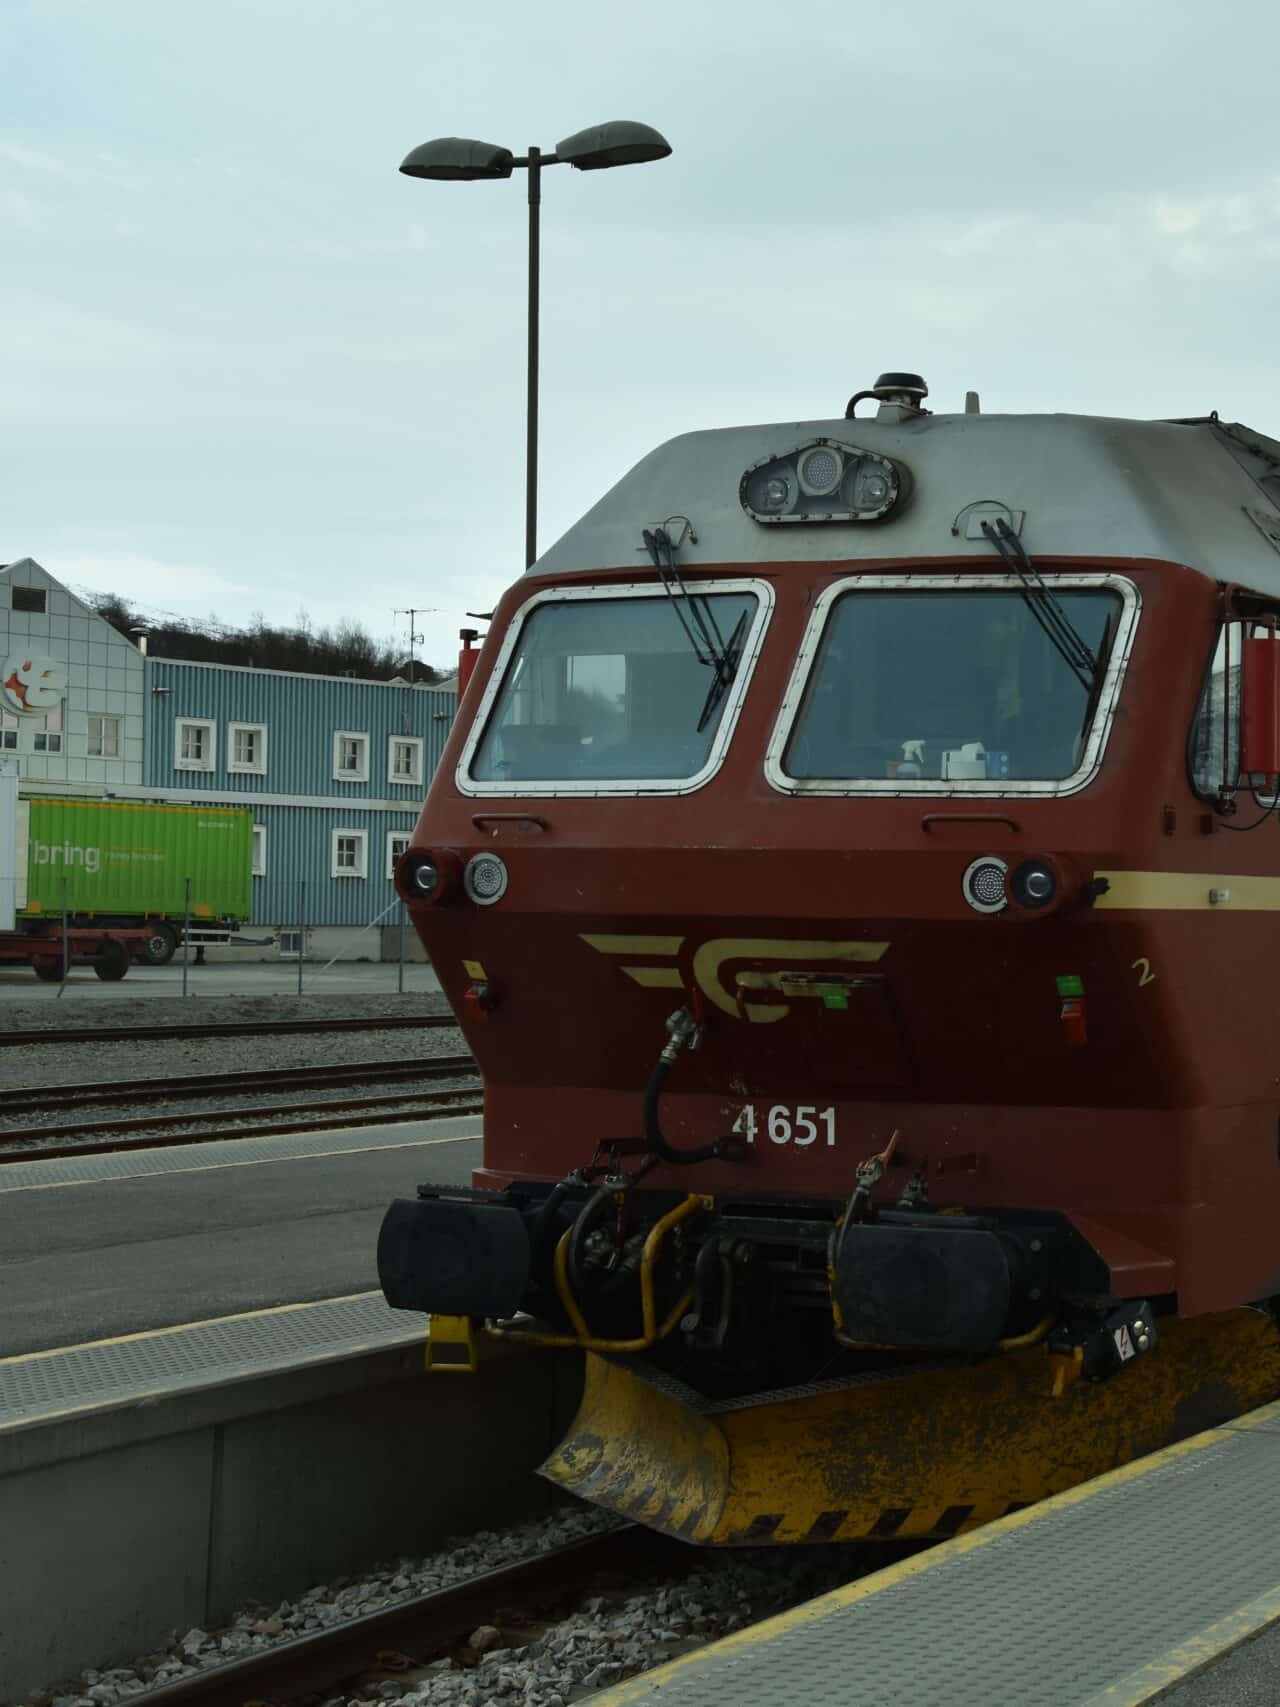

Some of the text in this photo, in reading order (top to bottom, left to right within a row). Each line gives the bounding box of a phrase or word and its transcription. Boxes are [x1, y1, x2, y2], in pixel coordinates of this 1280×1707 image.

[33, 840, 100, 873] bring
[1131, 958, 1155, 988] 2
[767, 1104, 836, 1146] 651
